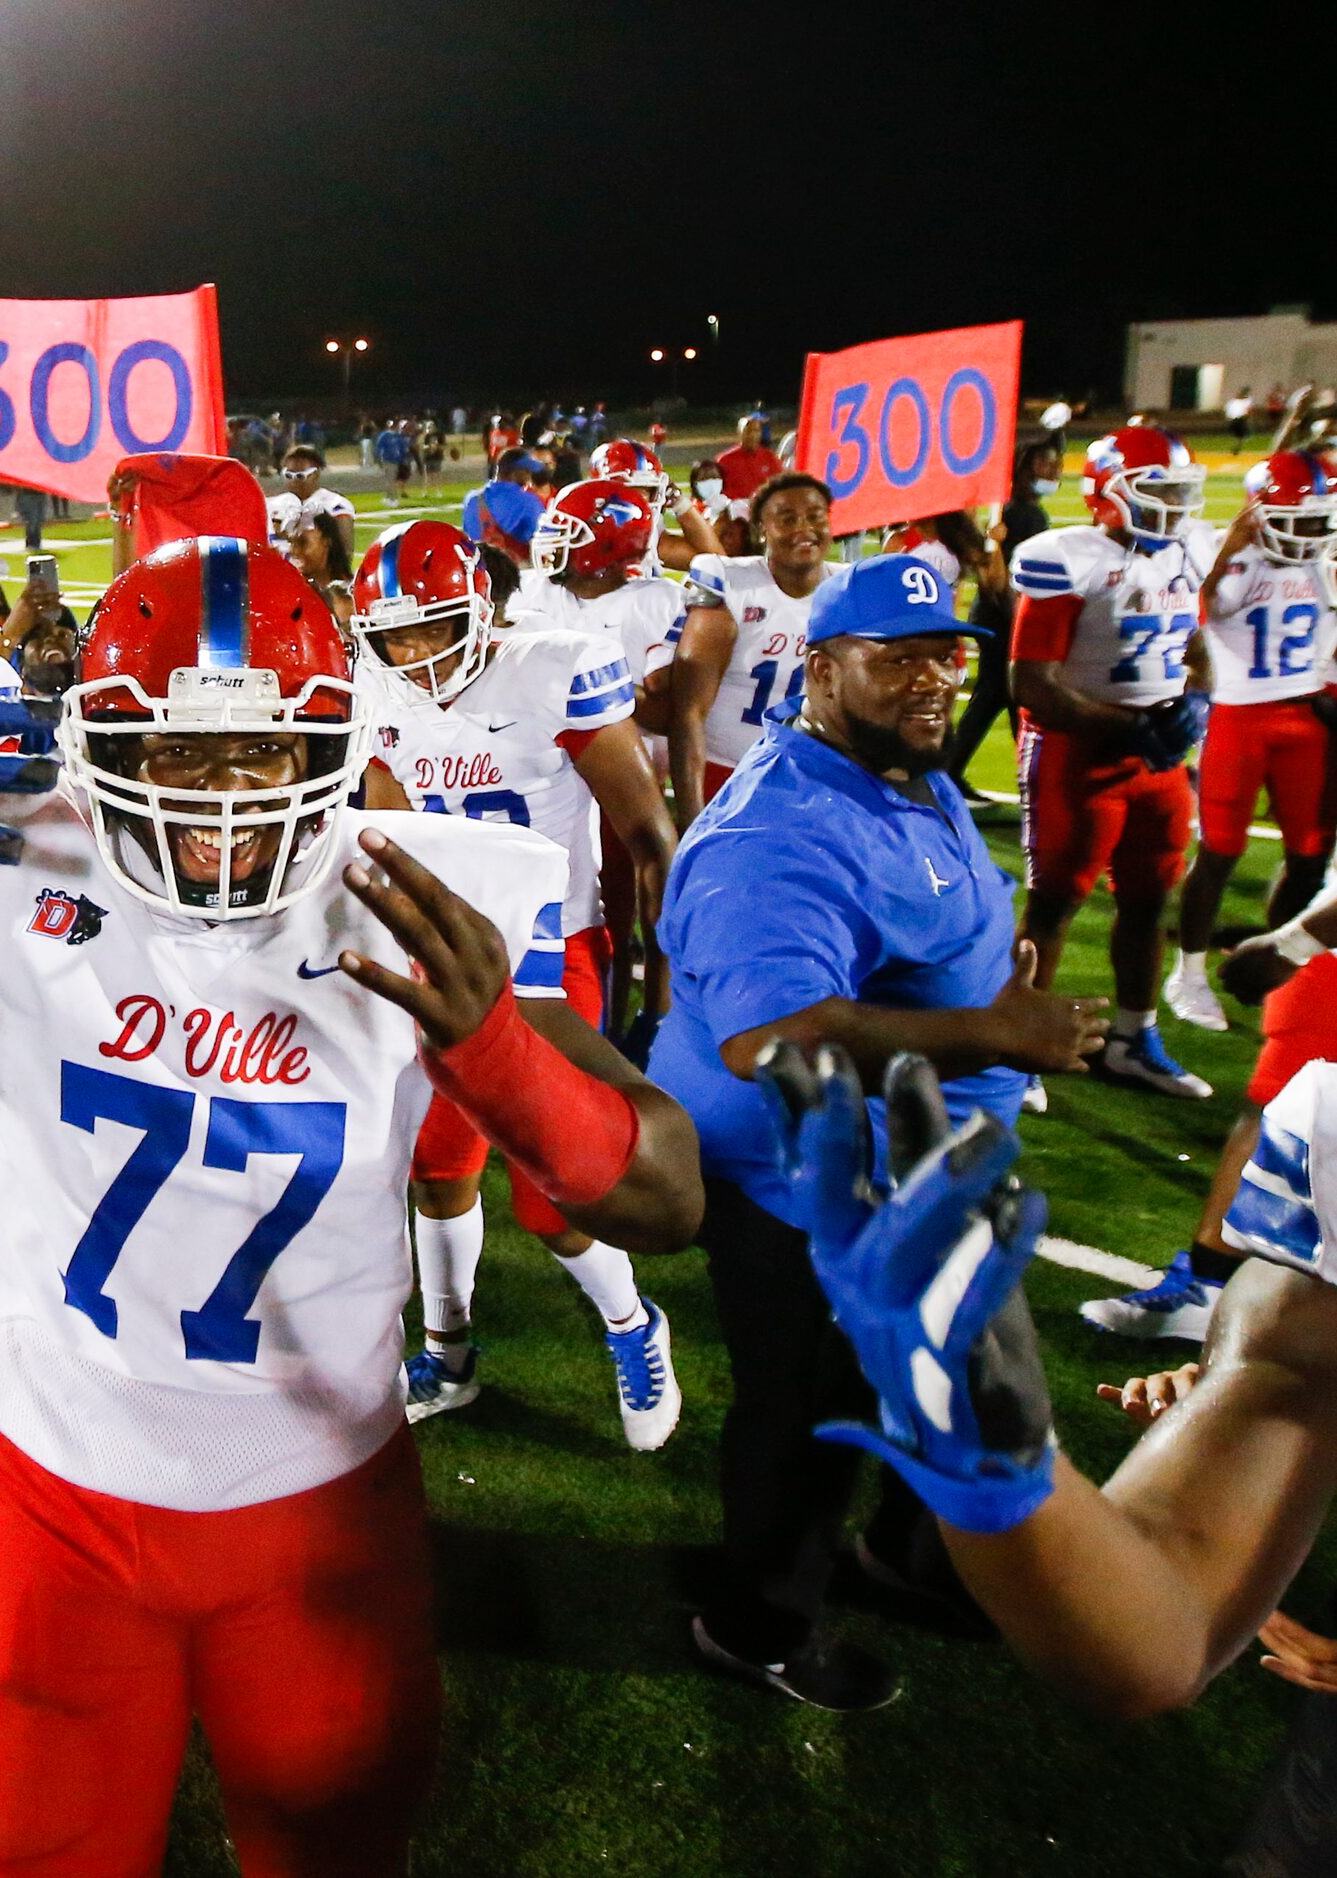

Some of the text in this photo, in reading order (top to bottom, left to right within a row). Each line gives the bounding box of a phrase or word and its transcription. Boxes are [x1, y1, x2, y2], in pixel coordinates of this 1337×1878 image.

[825, 367, 997, 501] 300
[901, 566, 940, 605] D
[1246, 604, 1320, 679] 12
[415, 752, 503, 790] D'Ville
[98, 994, 312, 1085] D'Ville
[57, 1059, 347, 1365] 77
